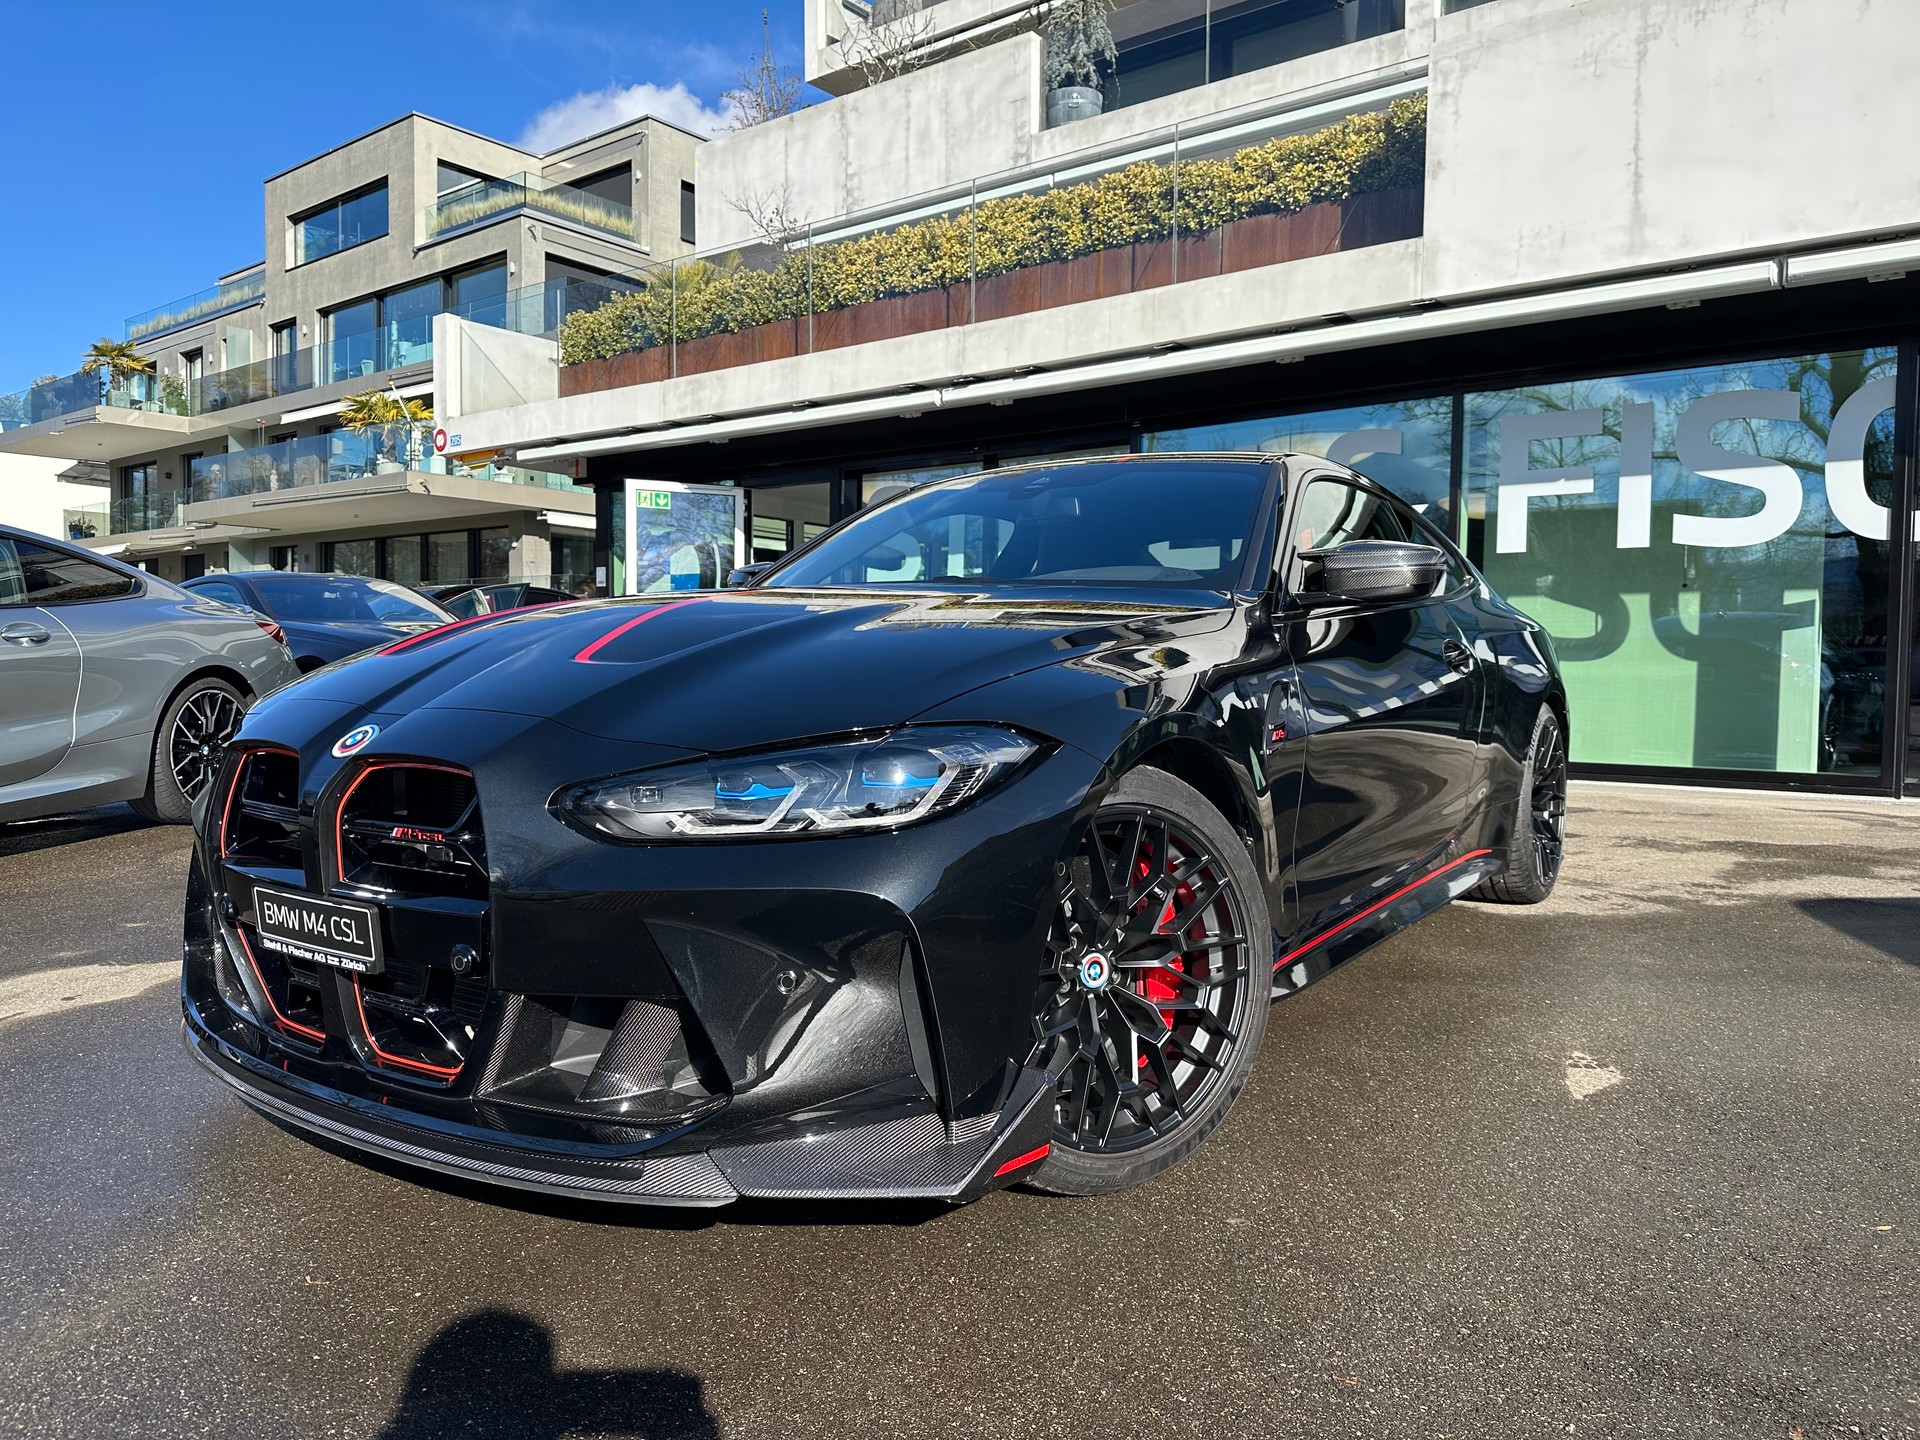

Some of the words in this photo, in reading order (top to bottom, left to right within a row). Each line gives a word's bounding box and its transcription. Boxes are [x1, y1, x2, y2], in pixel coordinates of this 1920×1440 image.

[450, 435, 461, 446] 205
[263, 901, 299, 931] BMW
[302, 910, 328, 937] M4
[330, 916, 365, 945] CSL
[282, 944, 288, 953] &
[288, 945, 314, 959] Fischer
[313, 952, 326, 963] AG
[340, 958, 366, 972] Zürich
